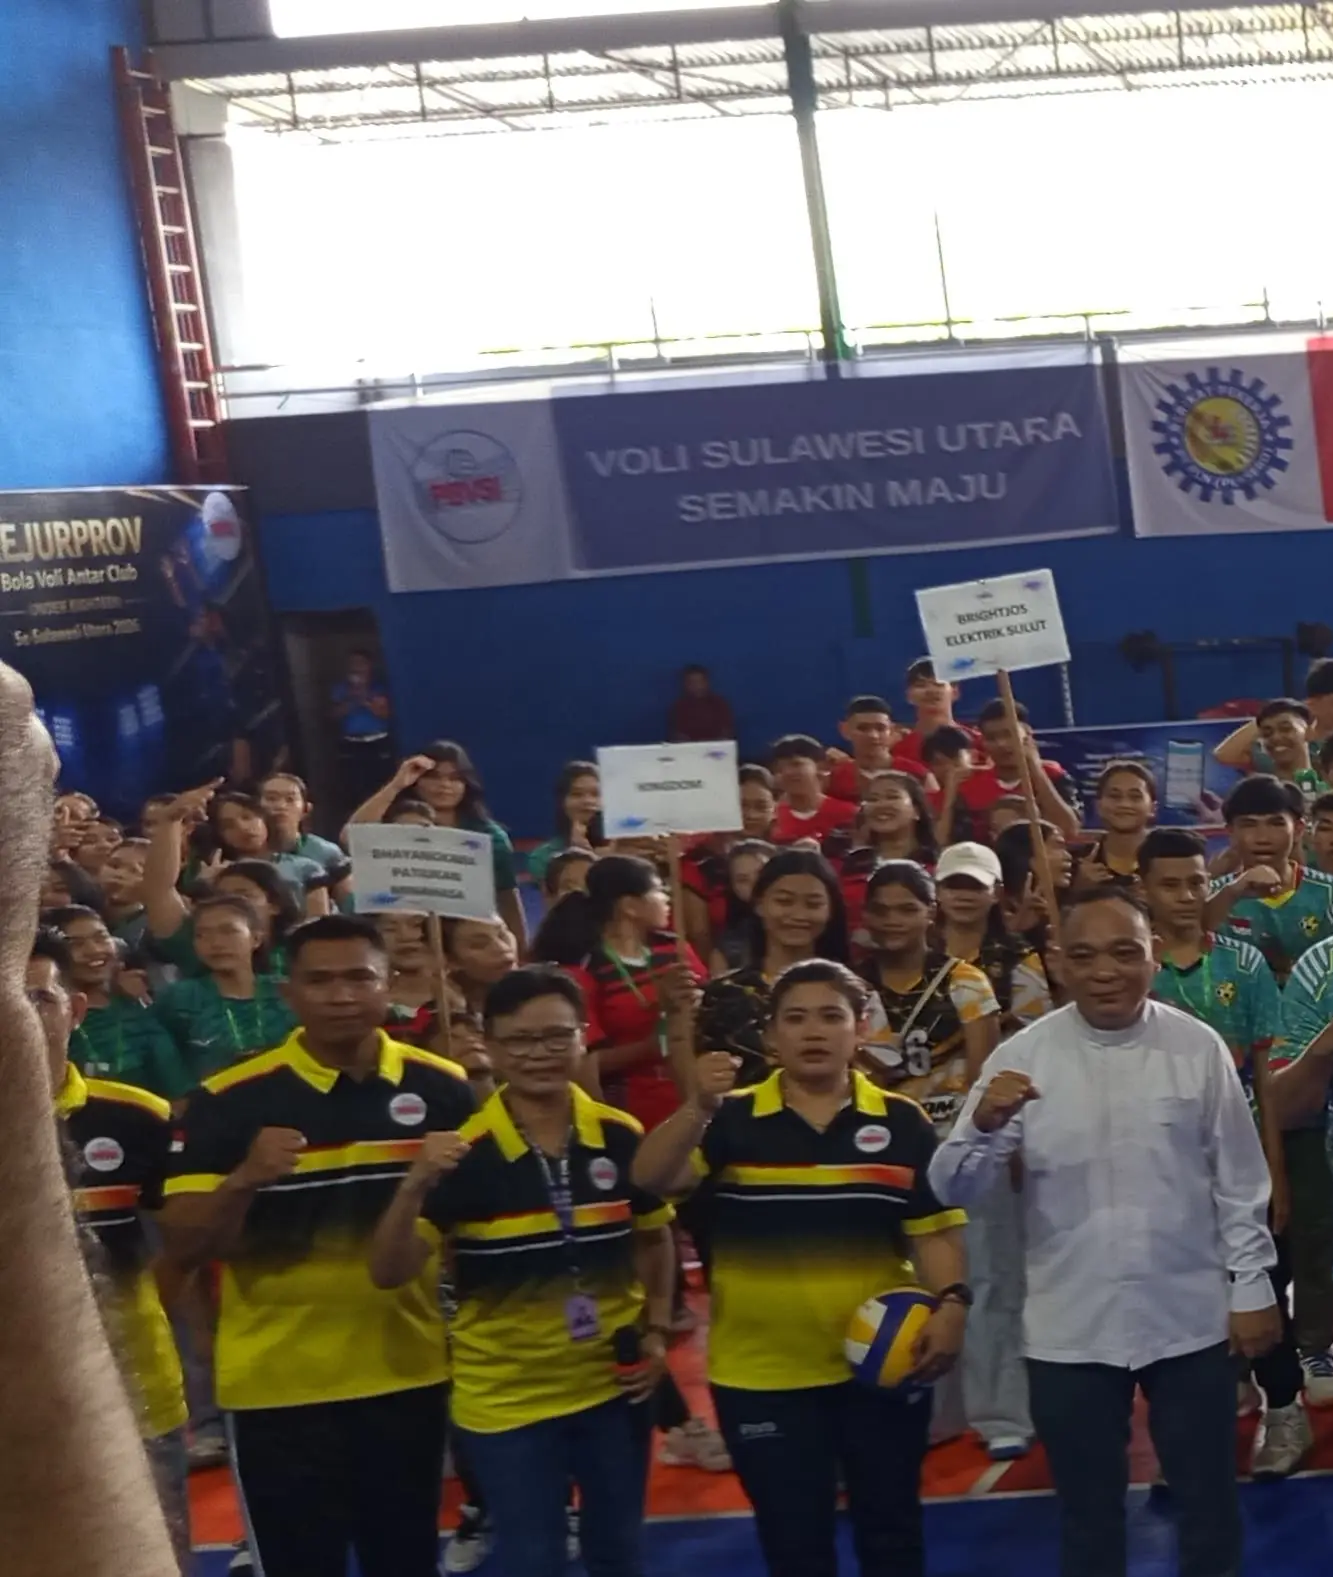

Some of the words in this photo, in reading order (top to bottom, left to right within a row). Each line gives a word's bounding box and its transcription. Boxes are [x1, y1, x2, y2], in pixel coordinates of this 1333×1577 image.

[587, 445, 689, 477] VOLI
[702, 427, 925, 468] SULAWESI
[937, 411, 1082, 452] UTARA
[678, 482, 875, 522] SEMAKIN
[886, 472, 1007, 507] MAJU
[0, 516, 142, 563] EJURPROV
[1, 570, 35, 592] Bola
[36, 568, 64, 588] Voli
[67, 565, 104, 585] Antar
[107, 562, 139, 582] Club
